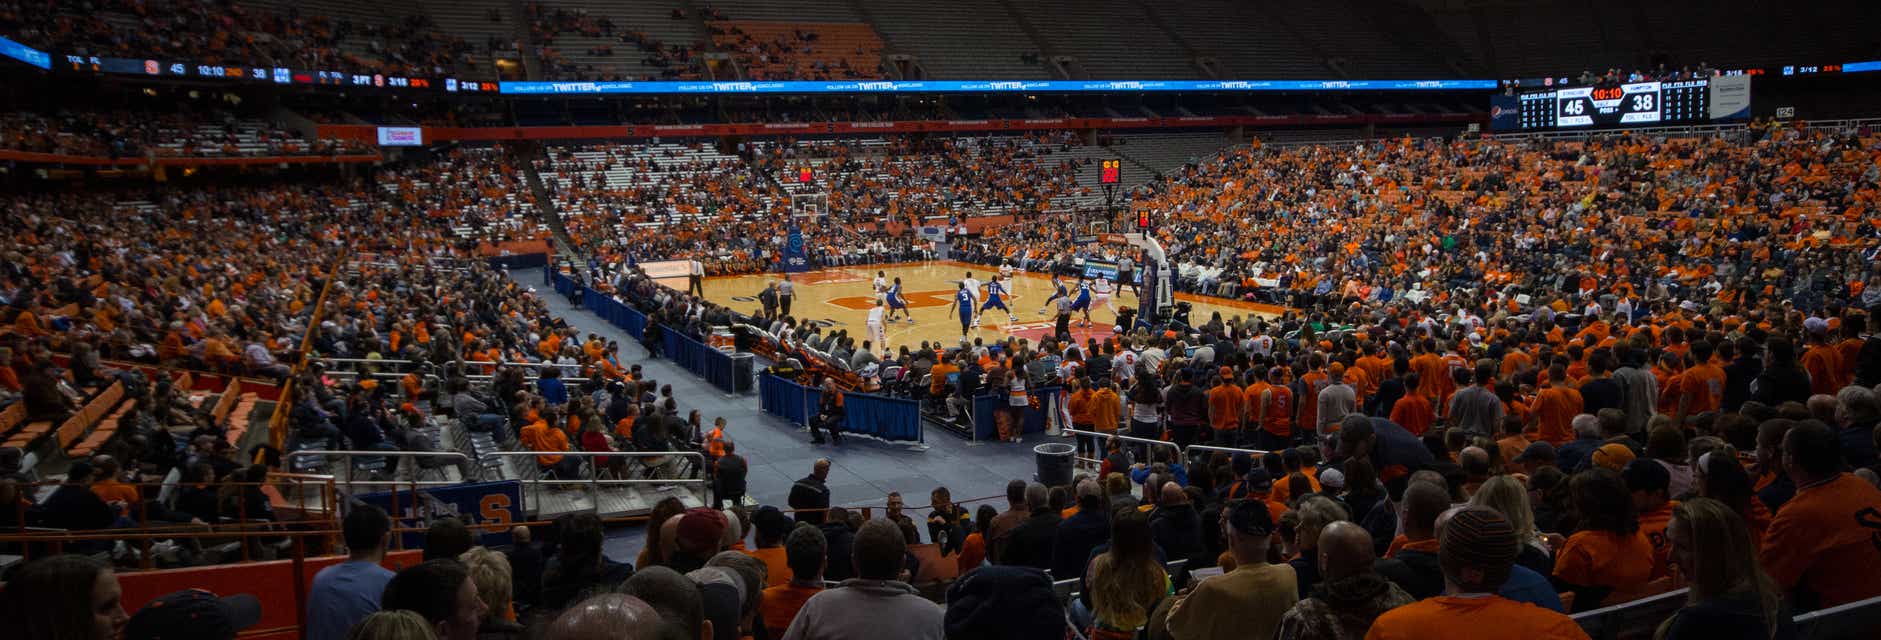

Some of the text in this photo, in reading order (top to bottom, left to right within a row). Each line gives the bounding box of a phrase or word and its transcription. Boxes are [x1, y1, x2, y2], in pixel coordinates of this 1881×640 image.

[171, 64, 184, 75] 45
[198, 65, 224, 77] 10:10
[253, 69, 266, 79] 38
[552, 82, 595, 92] TWITTER
[713, 81, 751, 91] TWITTER
[858, 81, 893, 91] TWITTER
[990, 81, 1022, 90] TWITTER
[1593, 87, 1621, 100] 10:10
[1565, 99, 1584, 115] 45
[1632, 94, 1653, 111] 38
[962, 293, 969, 301] 3
[480, 493, 513, 534] S
